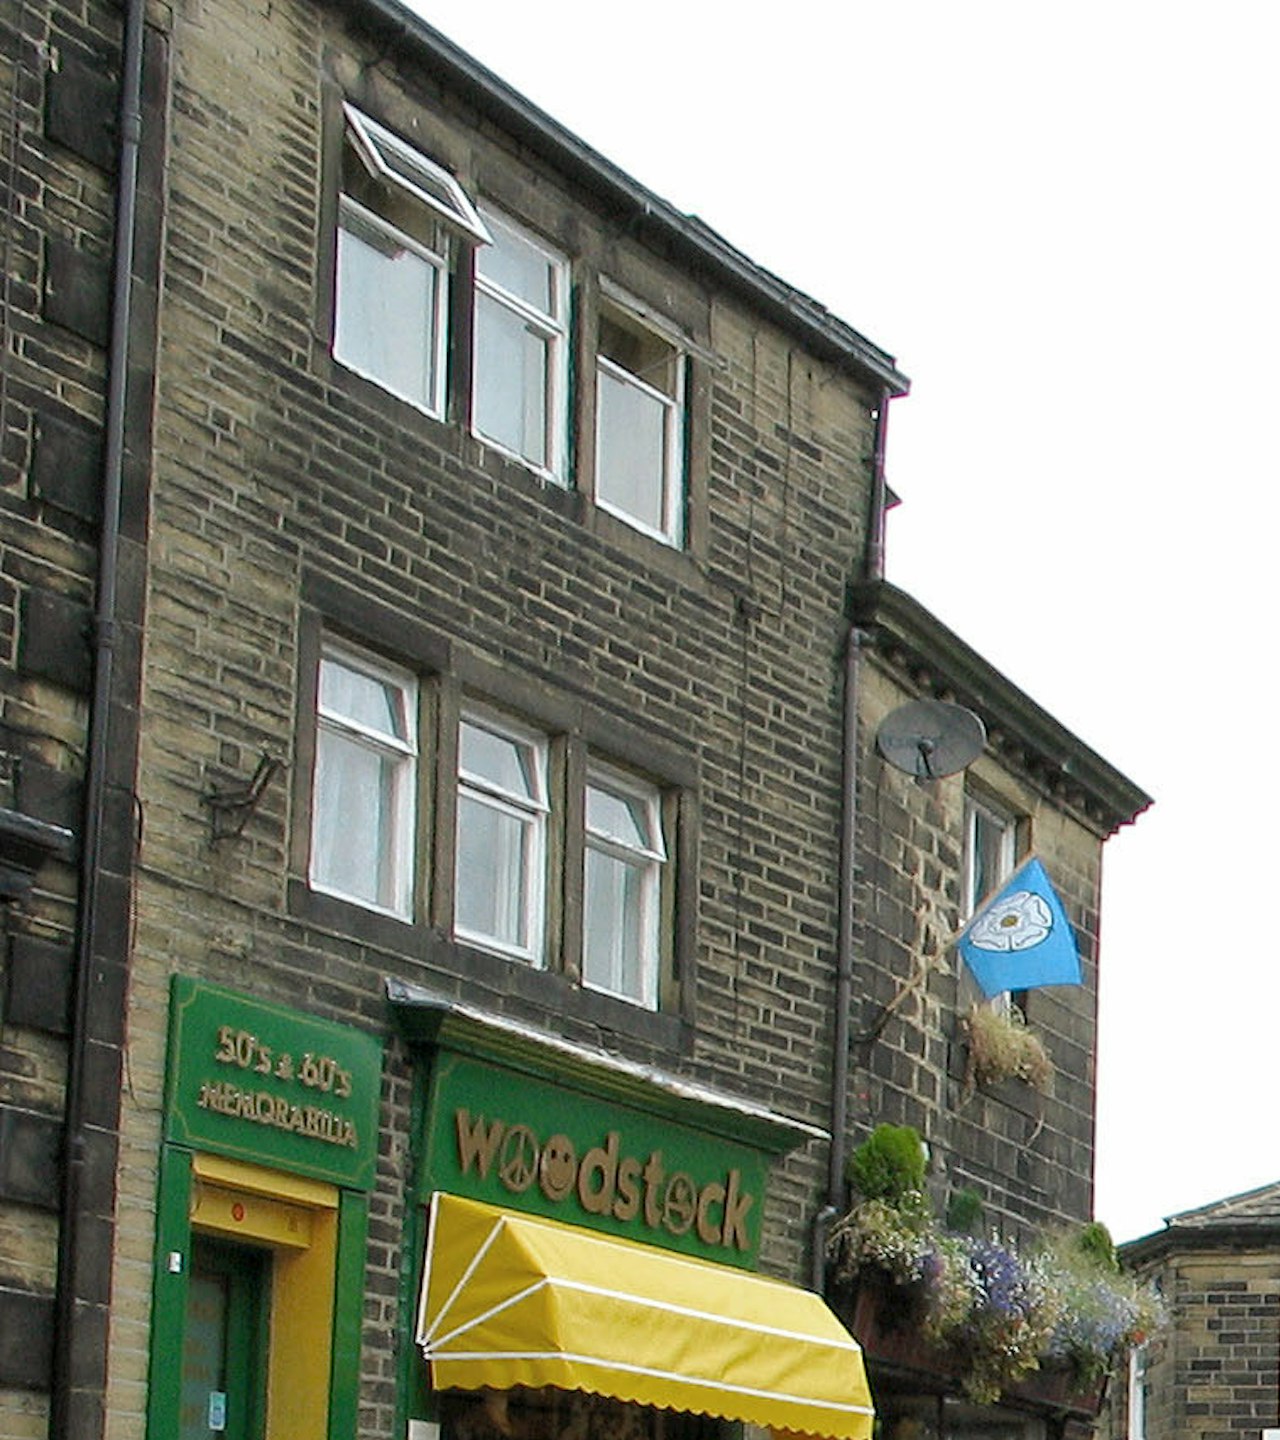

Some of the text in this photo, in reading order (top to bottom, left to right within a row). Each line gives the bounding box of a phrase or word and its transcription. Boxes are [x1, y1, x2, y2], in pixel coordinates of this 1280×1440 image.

[215, 1025, 352, 1098] 50's & 60's
